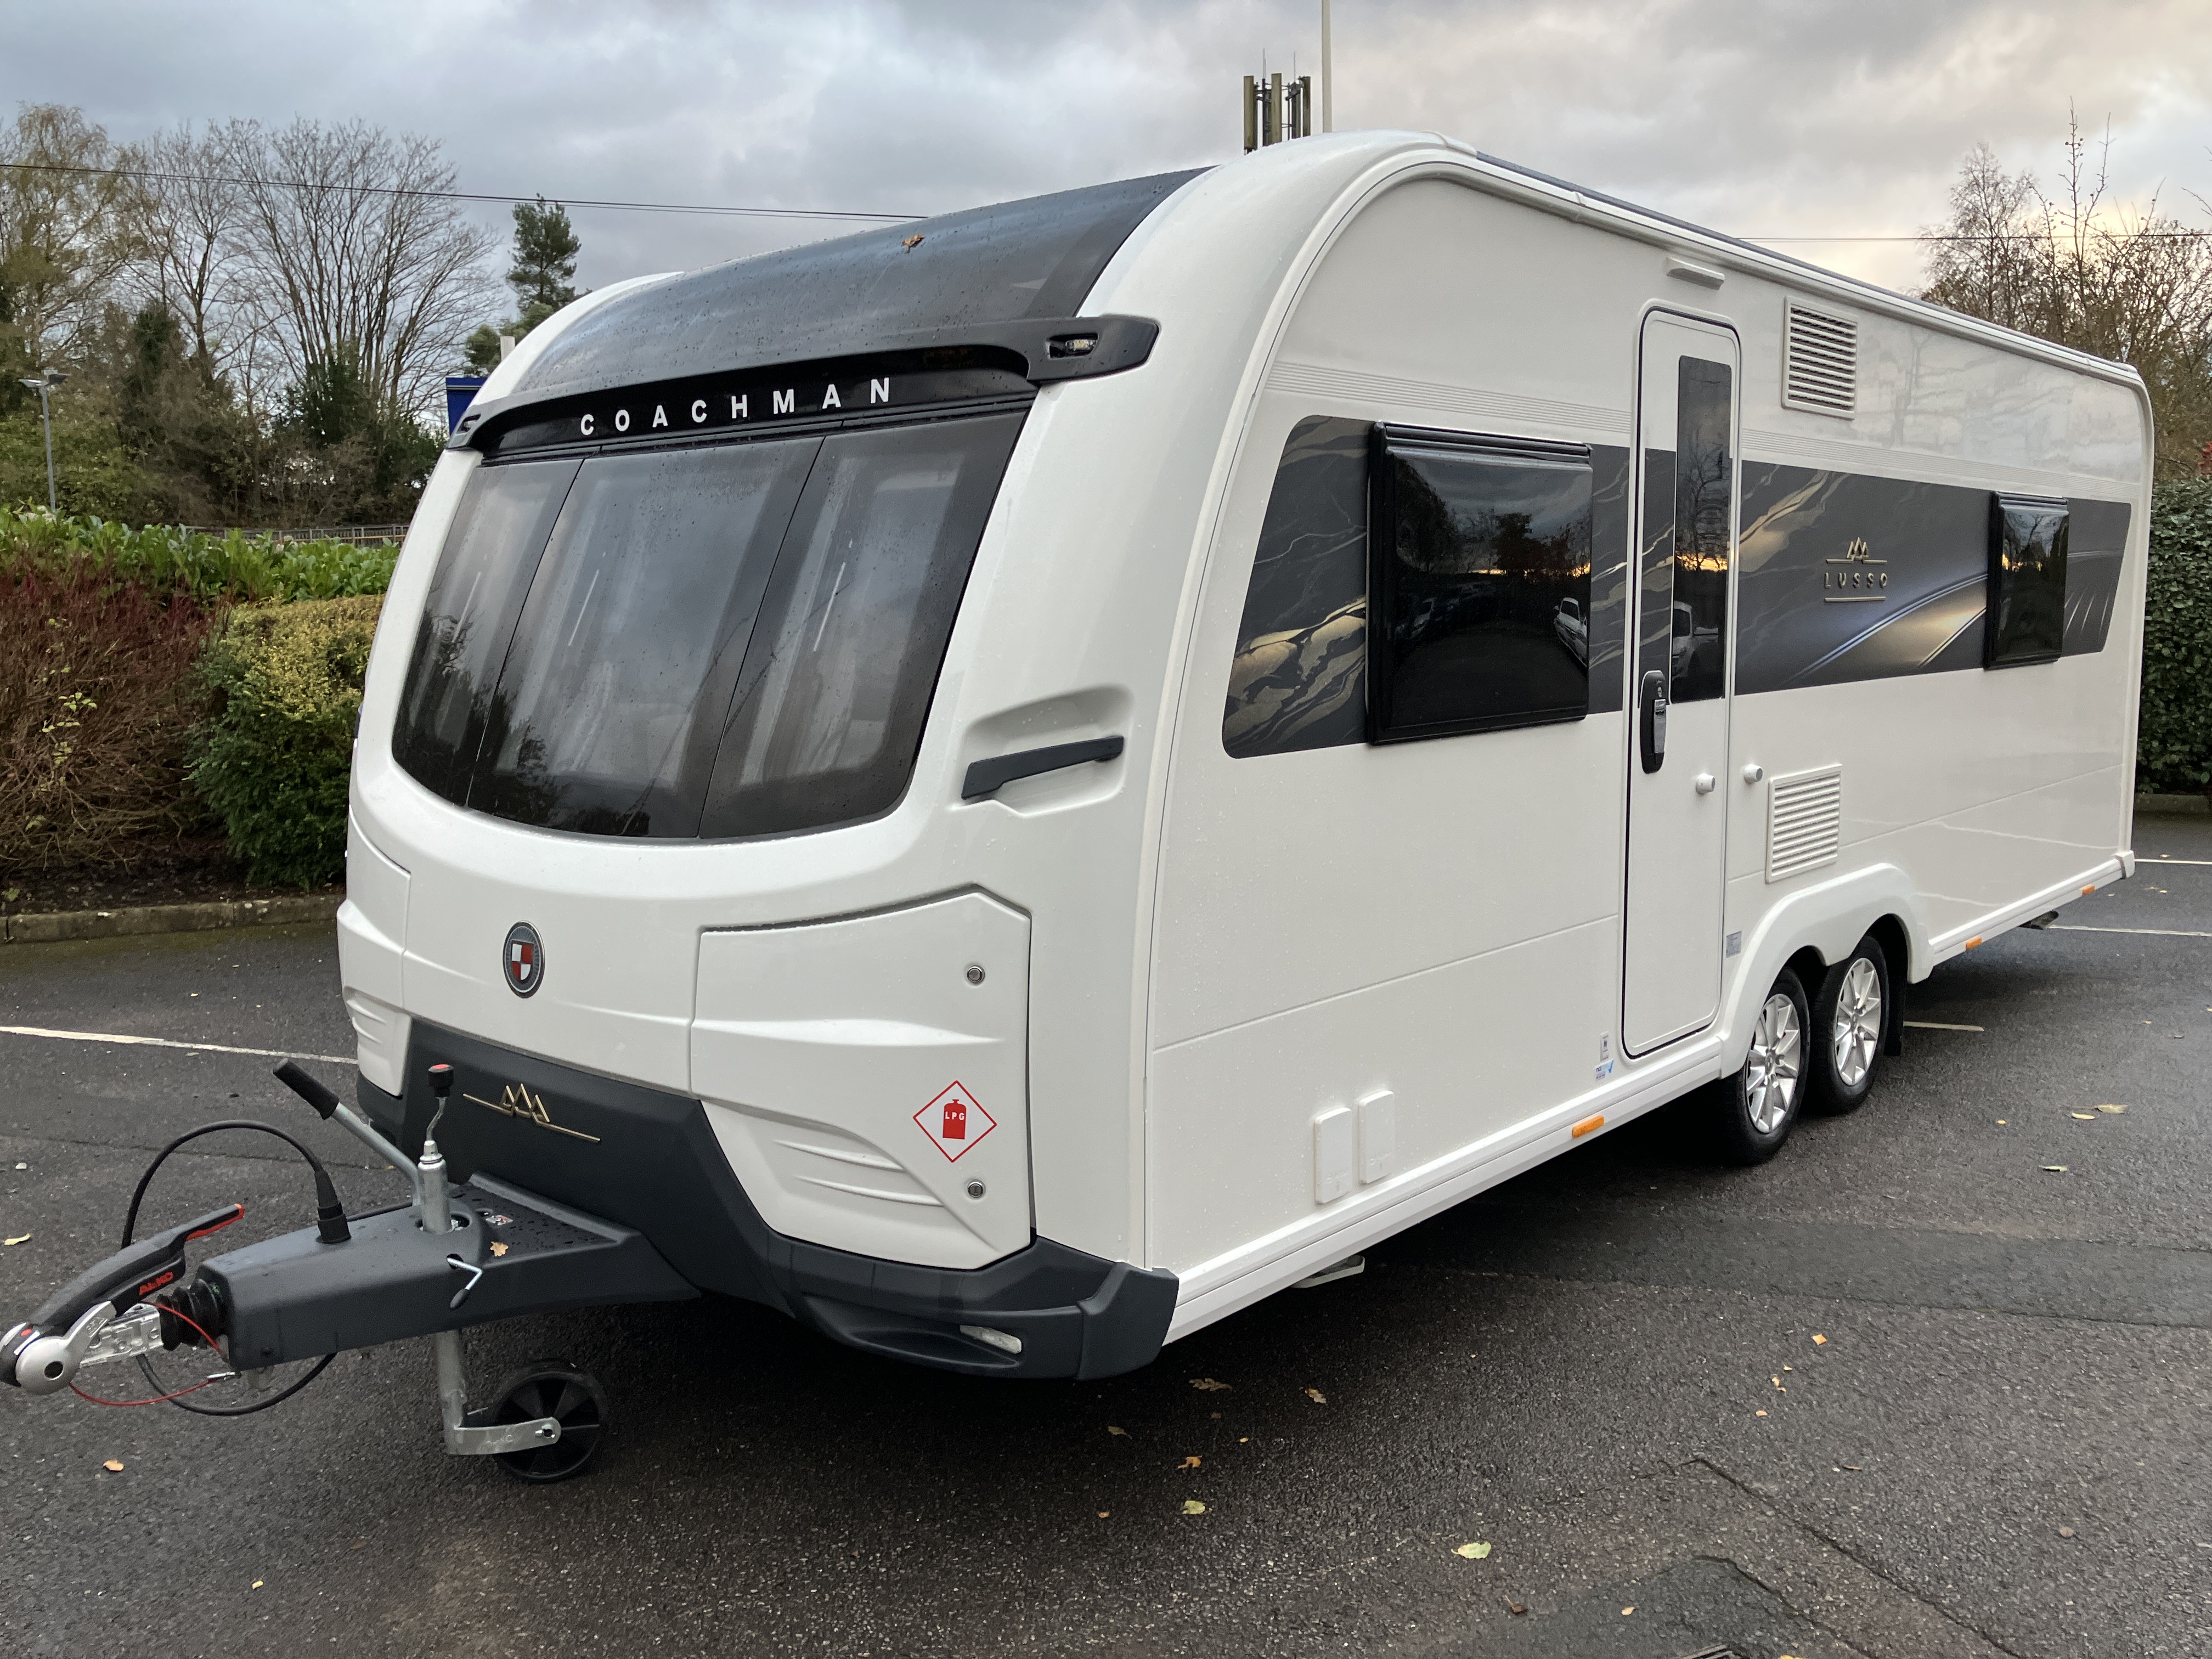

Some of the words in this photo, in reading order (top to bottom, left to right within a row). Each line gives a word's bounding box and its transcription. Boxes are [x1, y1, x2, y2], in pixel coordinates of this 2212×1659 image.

[580, 377, 890, 436] COACHMAN
[1825, 572, 1888, 589] LUSSO
[945, 1111, 965, 1121] LPG
